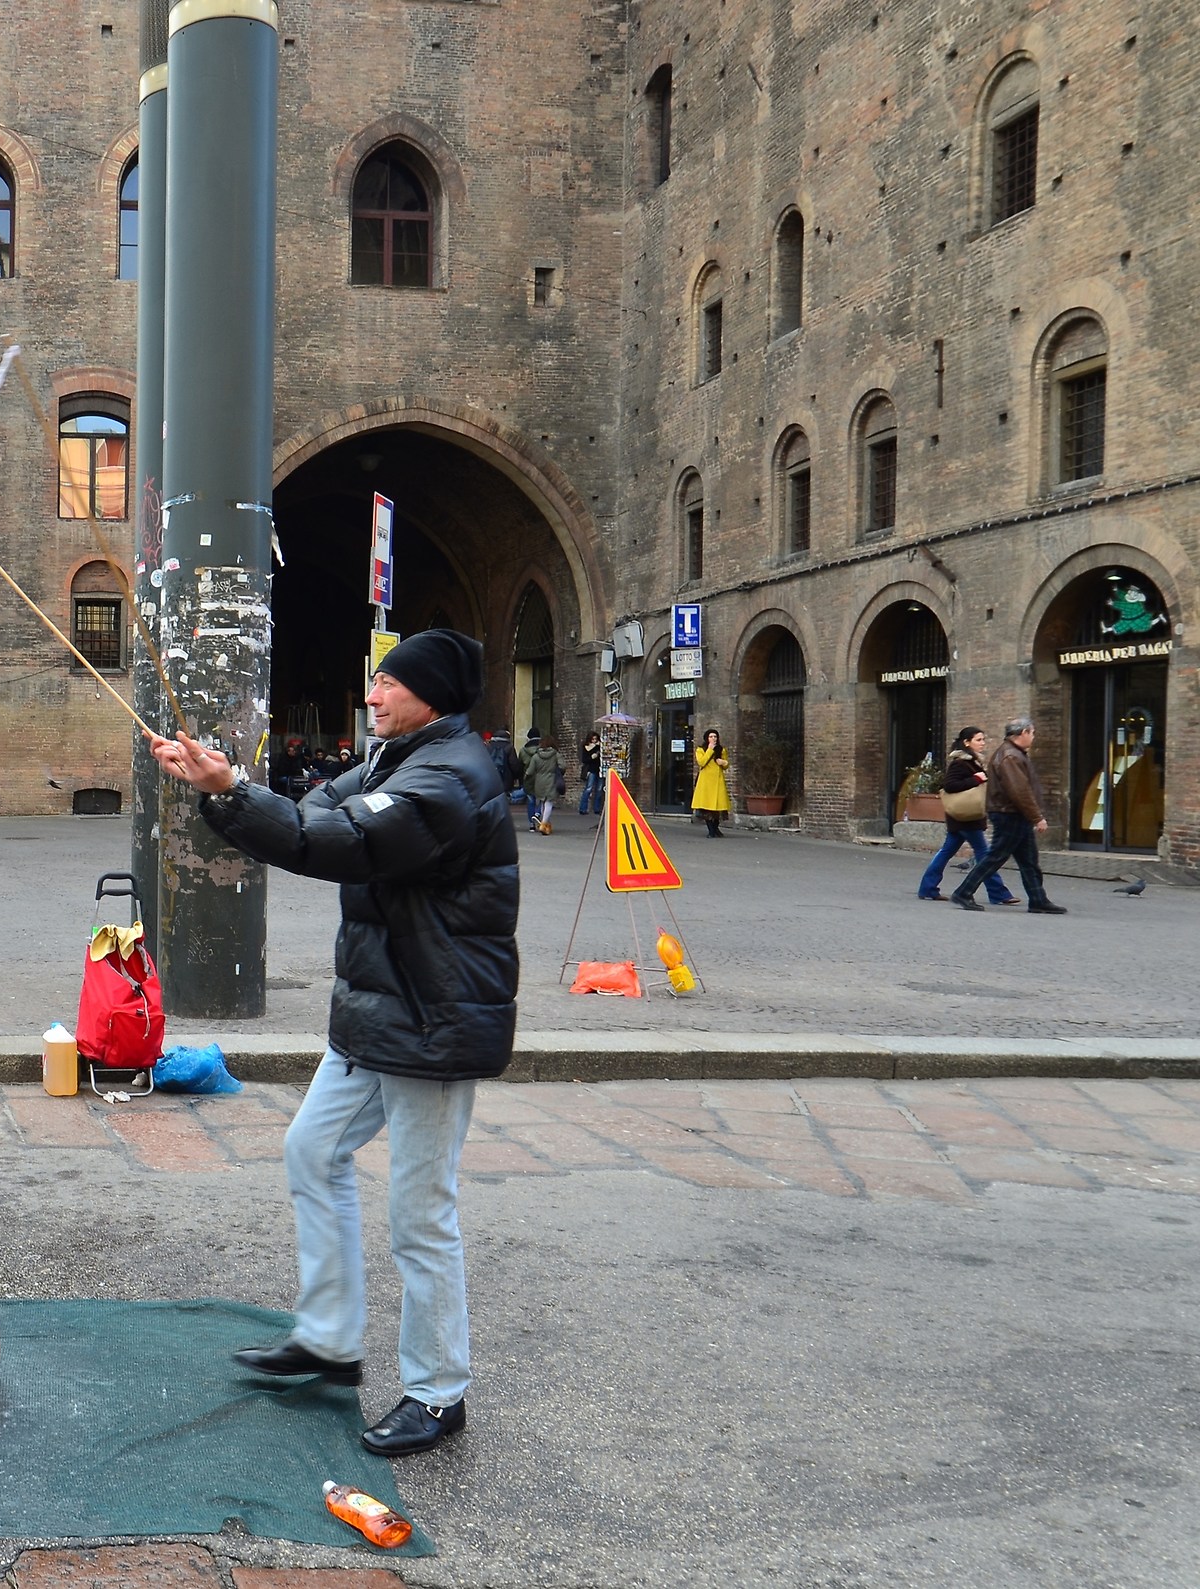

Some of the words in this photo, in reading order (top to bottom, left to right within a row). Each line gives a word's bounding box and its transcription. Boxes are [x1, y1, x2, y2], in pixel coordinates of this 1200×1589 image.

[676, 653, 692, 662] LOTTO
[1059, 650, 1113, 664] LIBRERIA
[1112, 645, 1137, 659] PER
